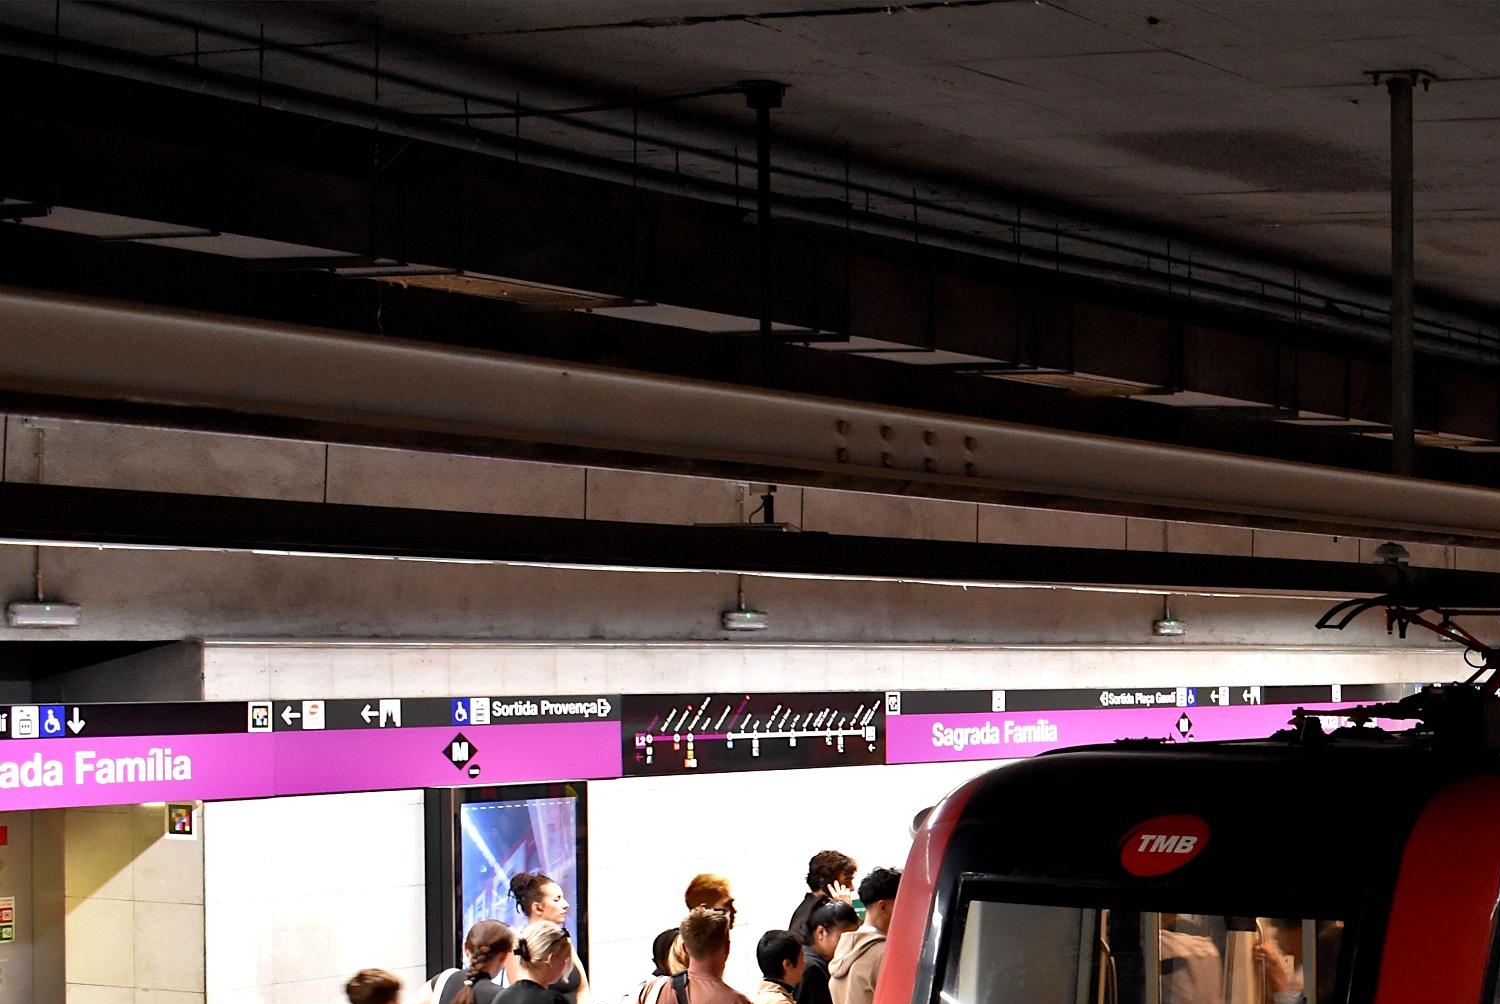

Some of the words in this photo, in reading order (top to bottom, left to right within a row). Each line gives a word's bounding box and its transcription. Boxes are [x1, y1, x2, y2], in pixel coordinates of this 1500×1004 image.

[492, 700, 539, 717] Sortida
[541, 698, 597, 718] Provença
[1108, 692, 1134, 705] Sortida
[1135, 691, 1154, 707] Plaça
[932, 721, 1000, 752] Sagrada
[1003, 718, 1058, 744] Família
[75, 747, 192, 785] Família
[1138, 834, 1198, 854] TMB
